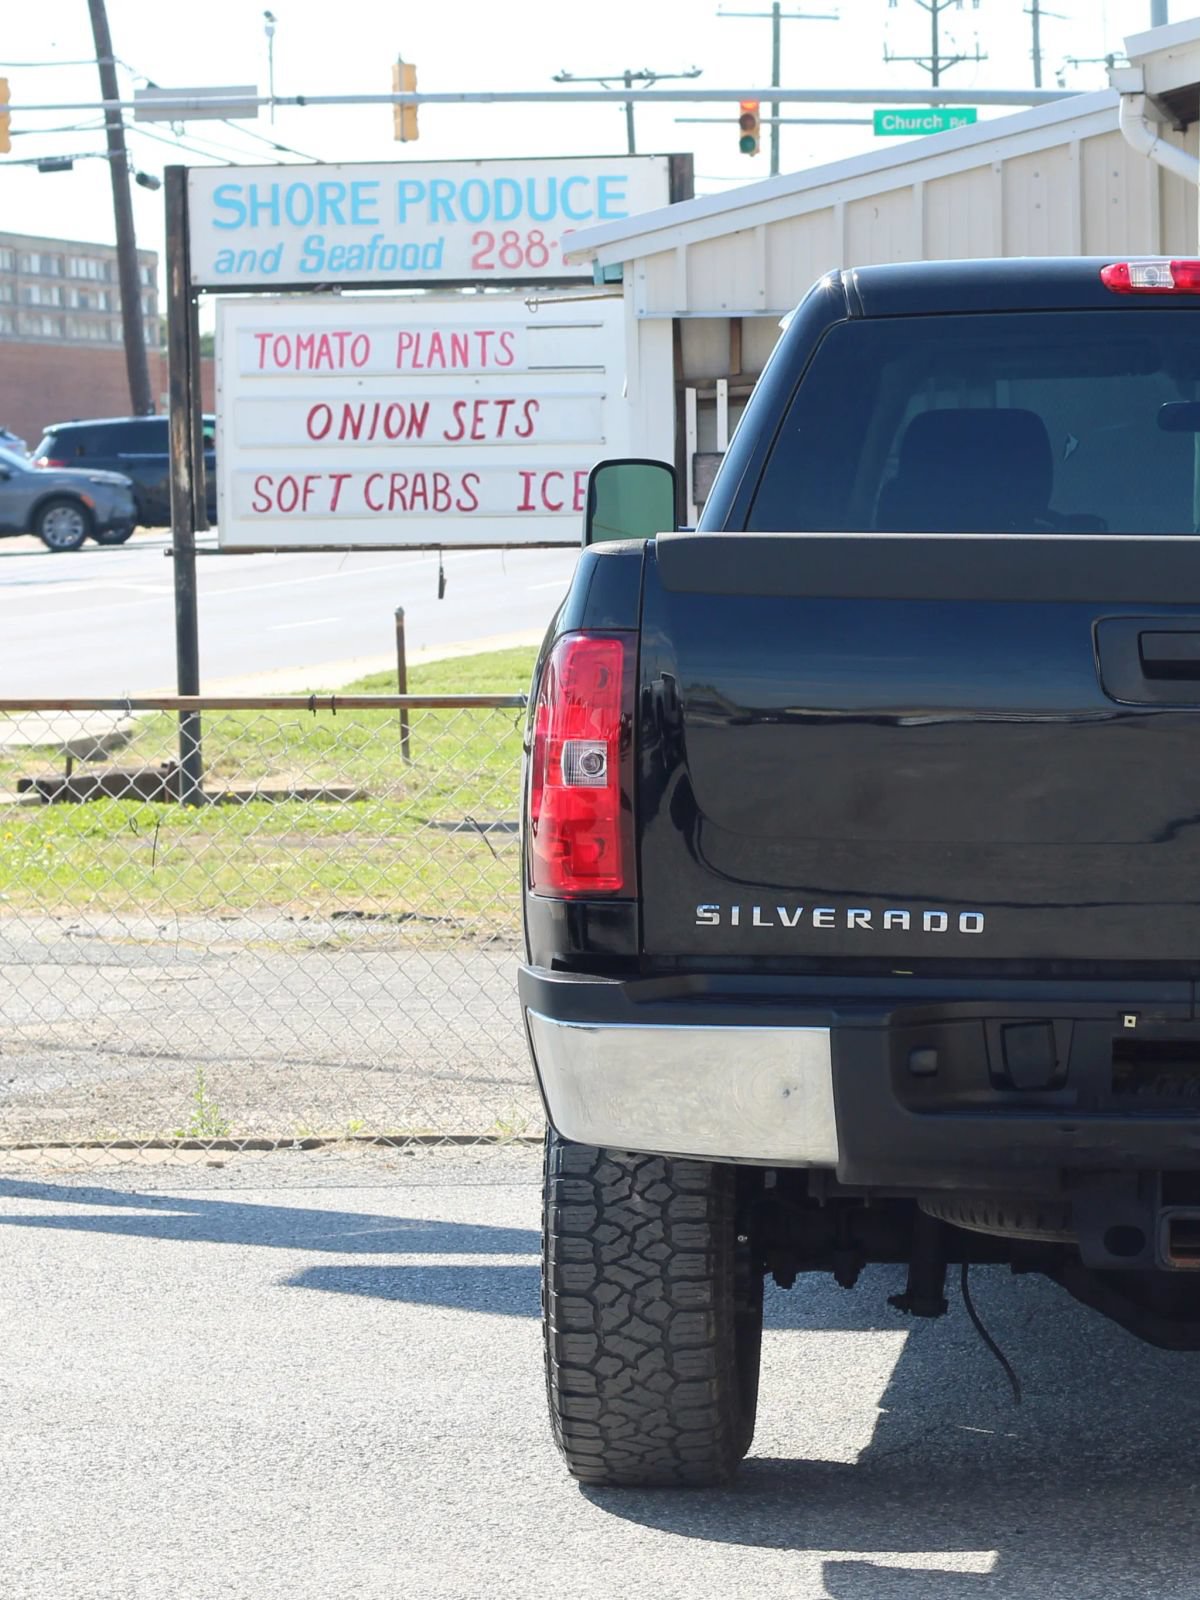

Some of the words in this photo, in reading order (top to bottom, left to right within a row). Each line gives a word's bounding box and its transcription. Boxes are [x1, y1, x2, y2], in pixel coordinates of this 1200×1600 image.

[882, 115, 943, 130] Church
[212, 180, 381, 230] SHORE
[398, 175, 629, 224] PRODUCE
[213, 241, 285, 274] and
[298, 234, 445, 273] Seafood
[471, 229, 582, 269] 288-
[254, 331, 371, 370] TOMATO
[396, 331, 515, 369] PLANTS
[306, 402, 430, 440] ONION
[443, 399, 540, 441] SETS
[252, 473, 353, 513] SOFT
[363, 471, 481, 512] CRABS
[516, 471, 589, 511] ICE
[695, 904, 985, 934] SILVERADO
